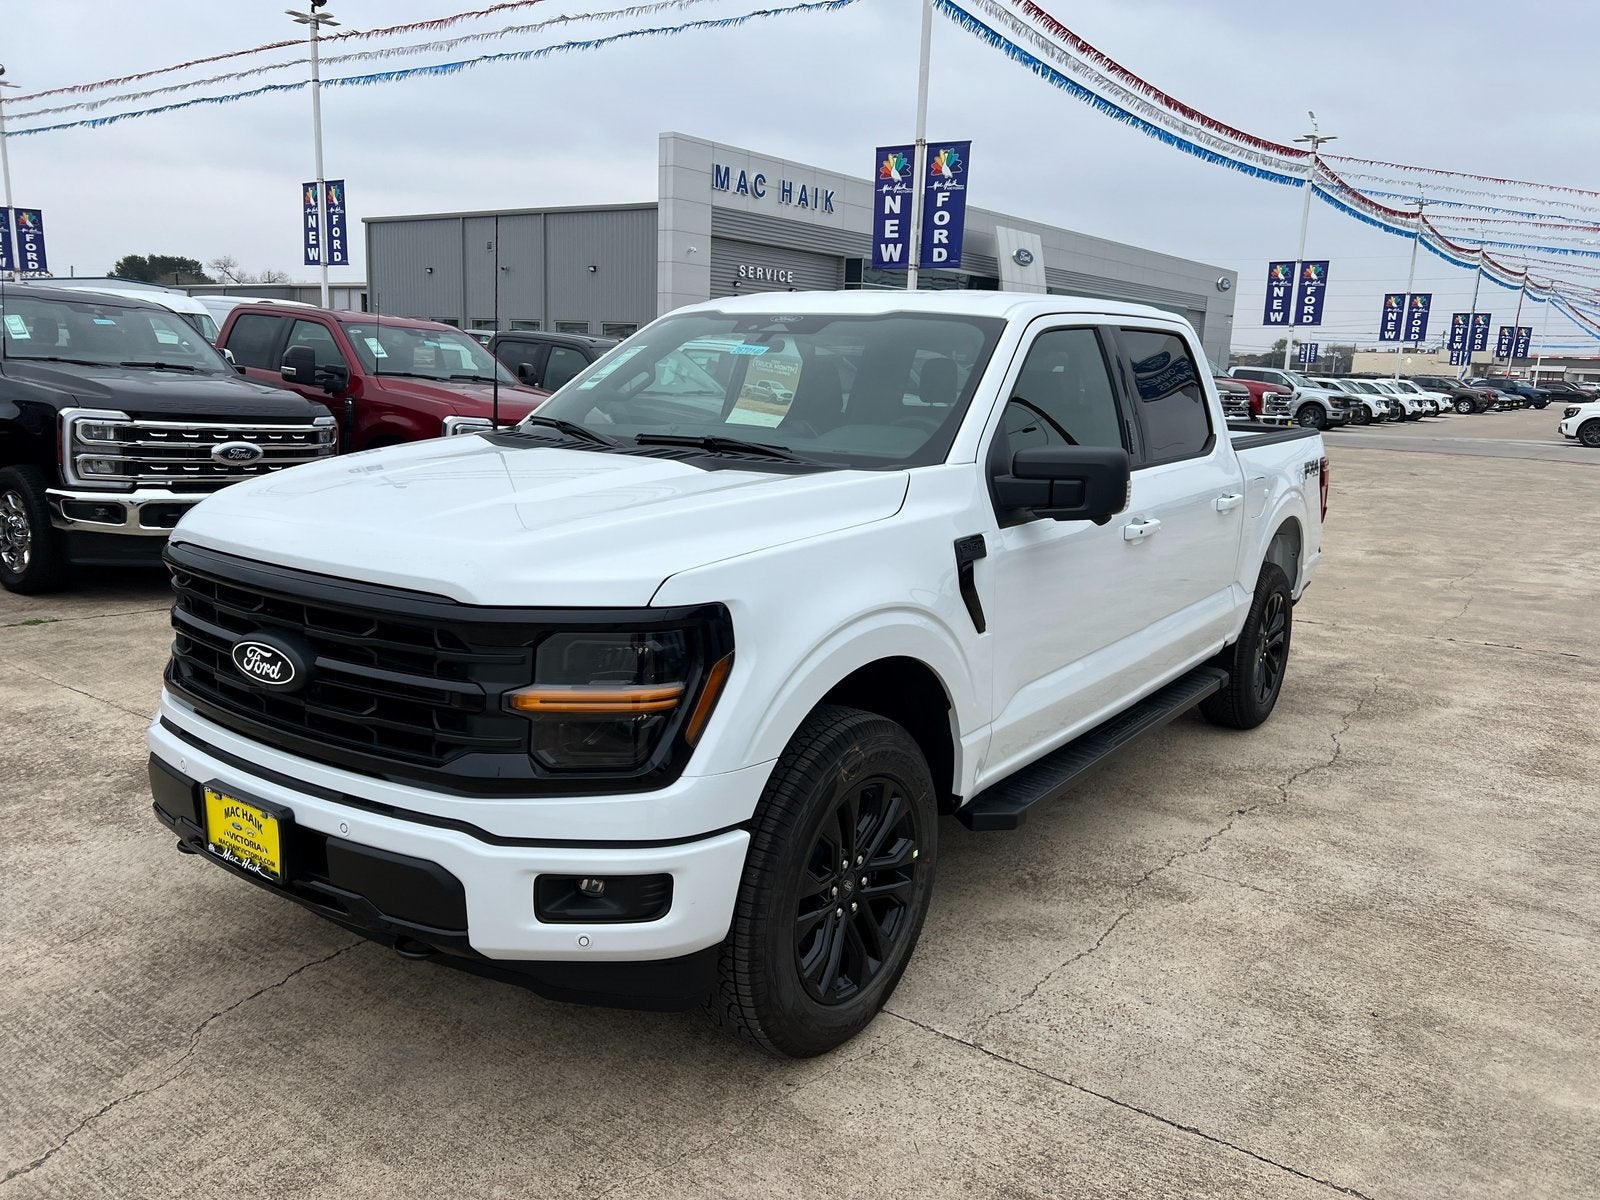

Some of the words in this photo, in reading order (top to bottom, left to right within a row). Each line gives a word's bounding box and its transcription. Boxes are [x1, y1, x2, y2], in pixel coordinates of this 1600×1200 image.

[713, 163, 767, 199] MAC
[779, 179, 835, 214] HAIK
[307, 215, 319, 261] NEW
[332, 215, 342, 262] FORD
[880, 195, 903, 262] NEW
[932, 192, 951, 262] FORD
[25, 234, 39, 270] FORD
[739, 264, 794, 283] SERVICE
[1269, 287, 1284, 322] NEW
[1302, 287, 1316, 323] FORD
[1384, 312, 1397, 339] NEW
[1410, 312, 1422, 340] FORD
[1453, 328, 1463, 349] NEW
[1473, 328, 1483, 350] FORD
[1499, 338, 1508, 357] NEW
[1516, 339, 1526, 358] FORD
[228, 448, 252, 459] Ford
[243, 646, 282, 680] Ford
[224, 806, 240, 819] MAC
[242, 809, 263, 835] HAIK
[229, 832, 262, 853] VICTORIA
[222, 848, 241, 866] Mac
[242, 858, 266, 875] Haik
